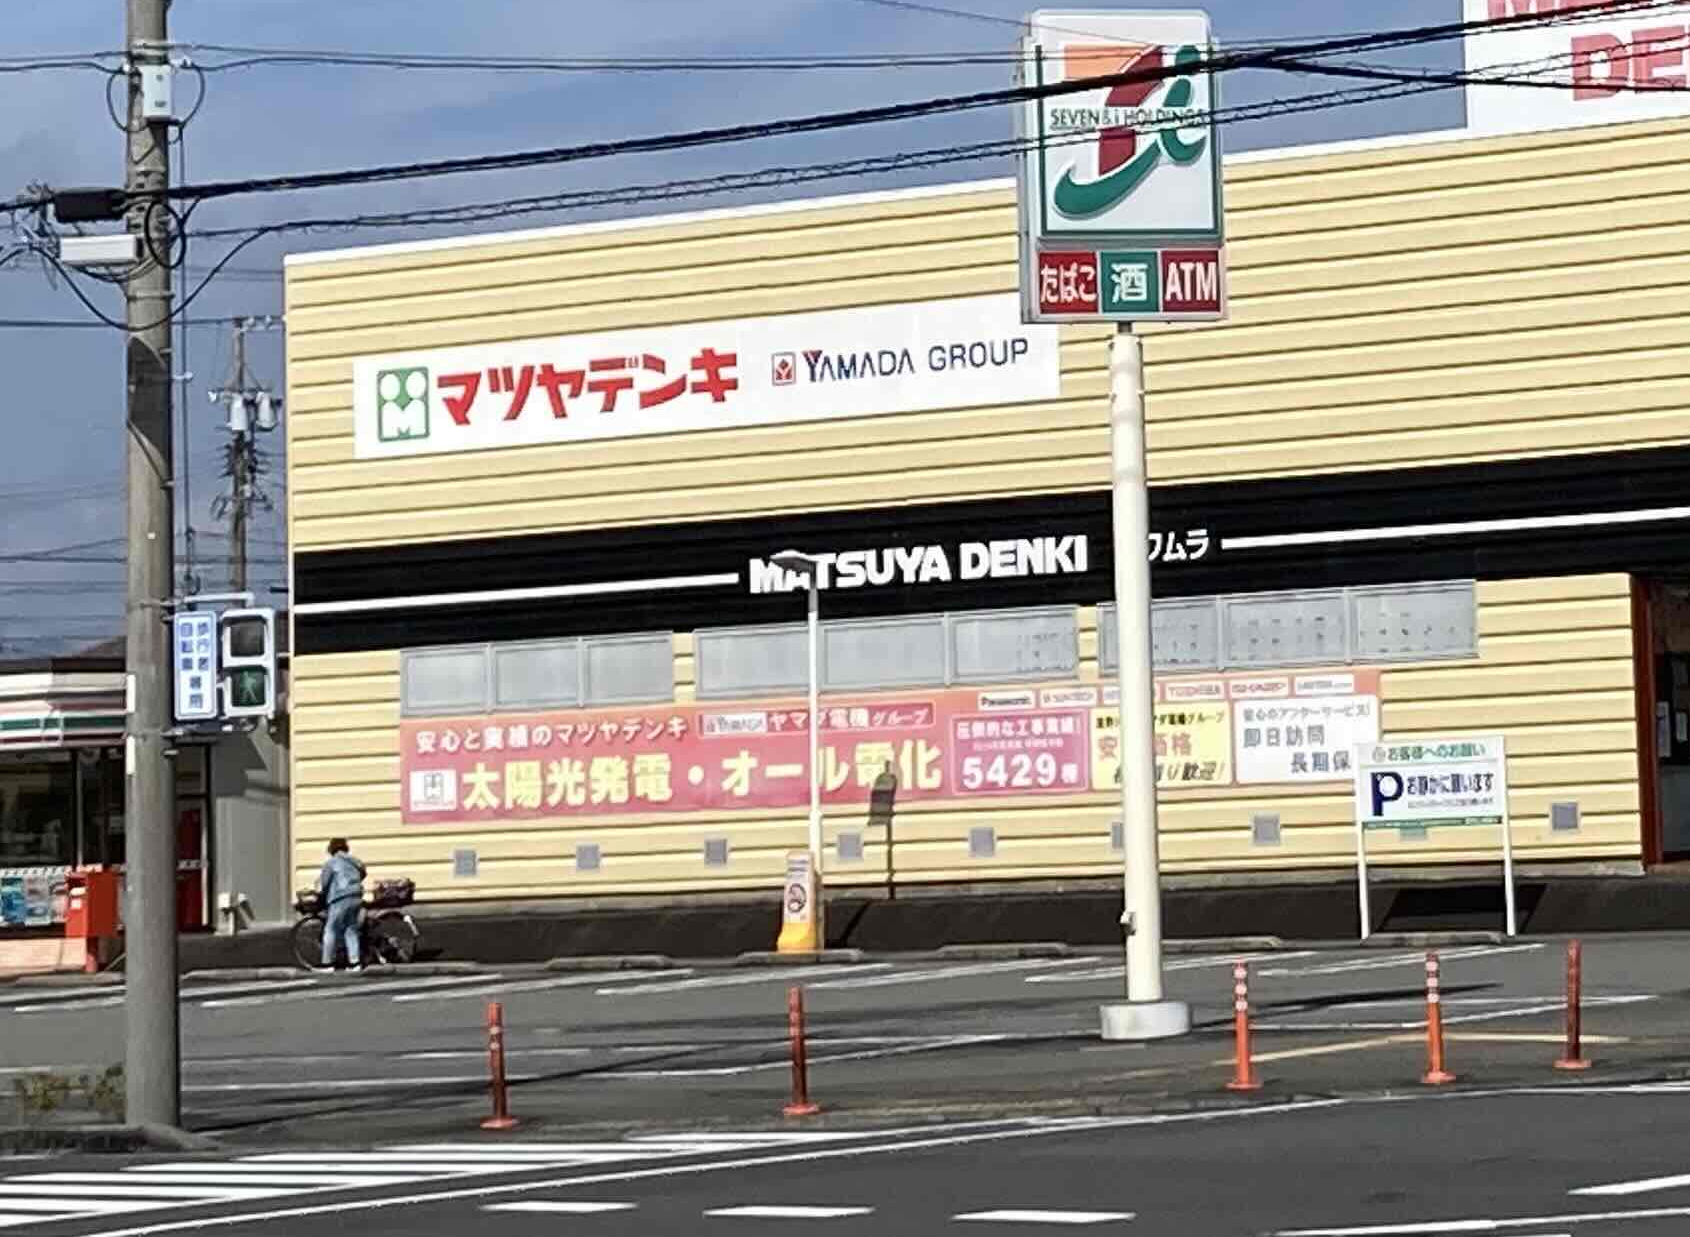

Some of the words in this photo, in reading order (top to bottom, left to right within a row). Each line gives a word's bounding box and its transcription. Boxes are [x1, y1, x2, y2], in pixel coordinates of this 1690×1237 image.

[1040, 261, 1098, 304] たばこ
[1111, 262, 1149, 304] 酒
[1165, 261, 1217, 302] ATM
[802, 348, 915, 383] YAMADA
[928, 337, 1029, 372] GROUP
[437, 347, 740, 426] マツヤデンキ
[960, 534, 1088, 580] DENKI
[1290, 750, 1352, 774] 長期保
[1370, 771, 1405, 817] P
